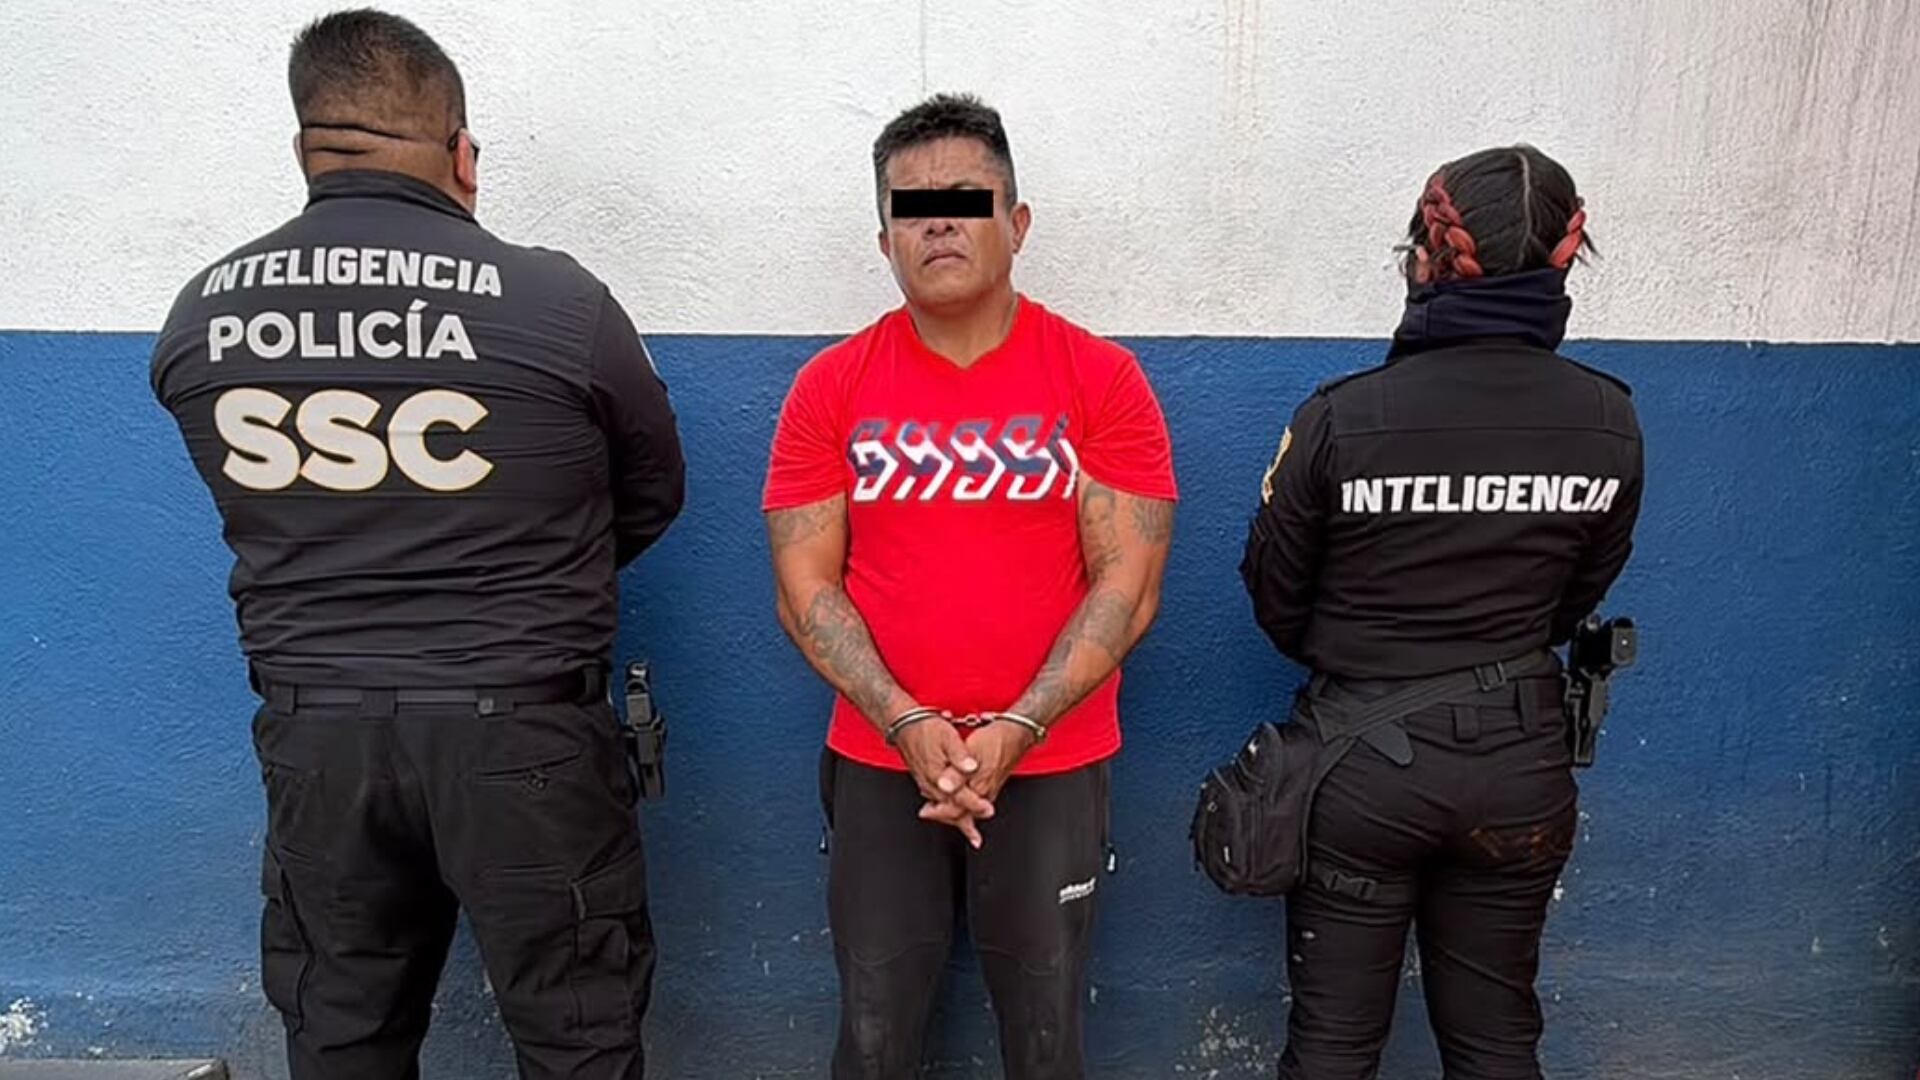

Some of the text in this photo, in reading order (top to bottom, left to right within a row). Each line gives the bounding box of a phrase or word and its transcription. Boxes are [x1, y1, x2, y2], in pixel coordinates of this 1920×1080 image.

[202, 247, 502, 297] INTELIGENCIA
[208, 299, 477, 361] POLICÍA
[214, 388, 494, 491] SSC
